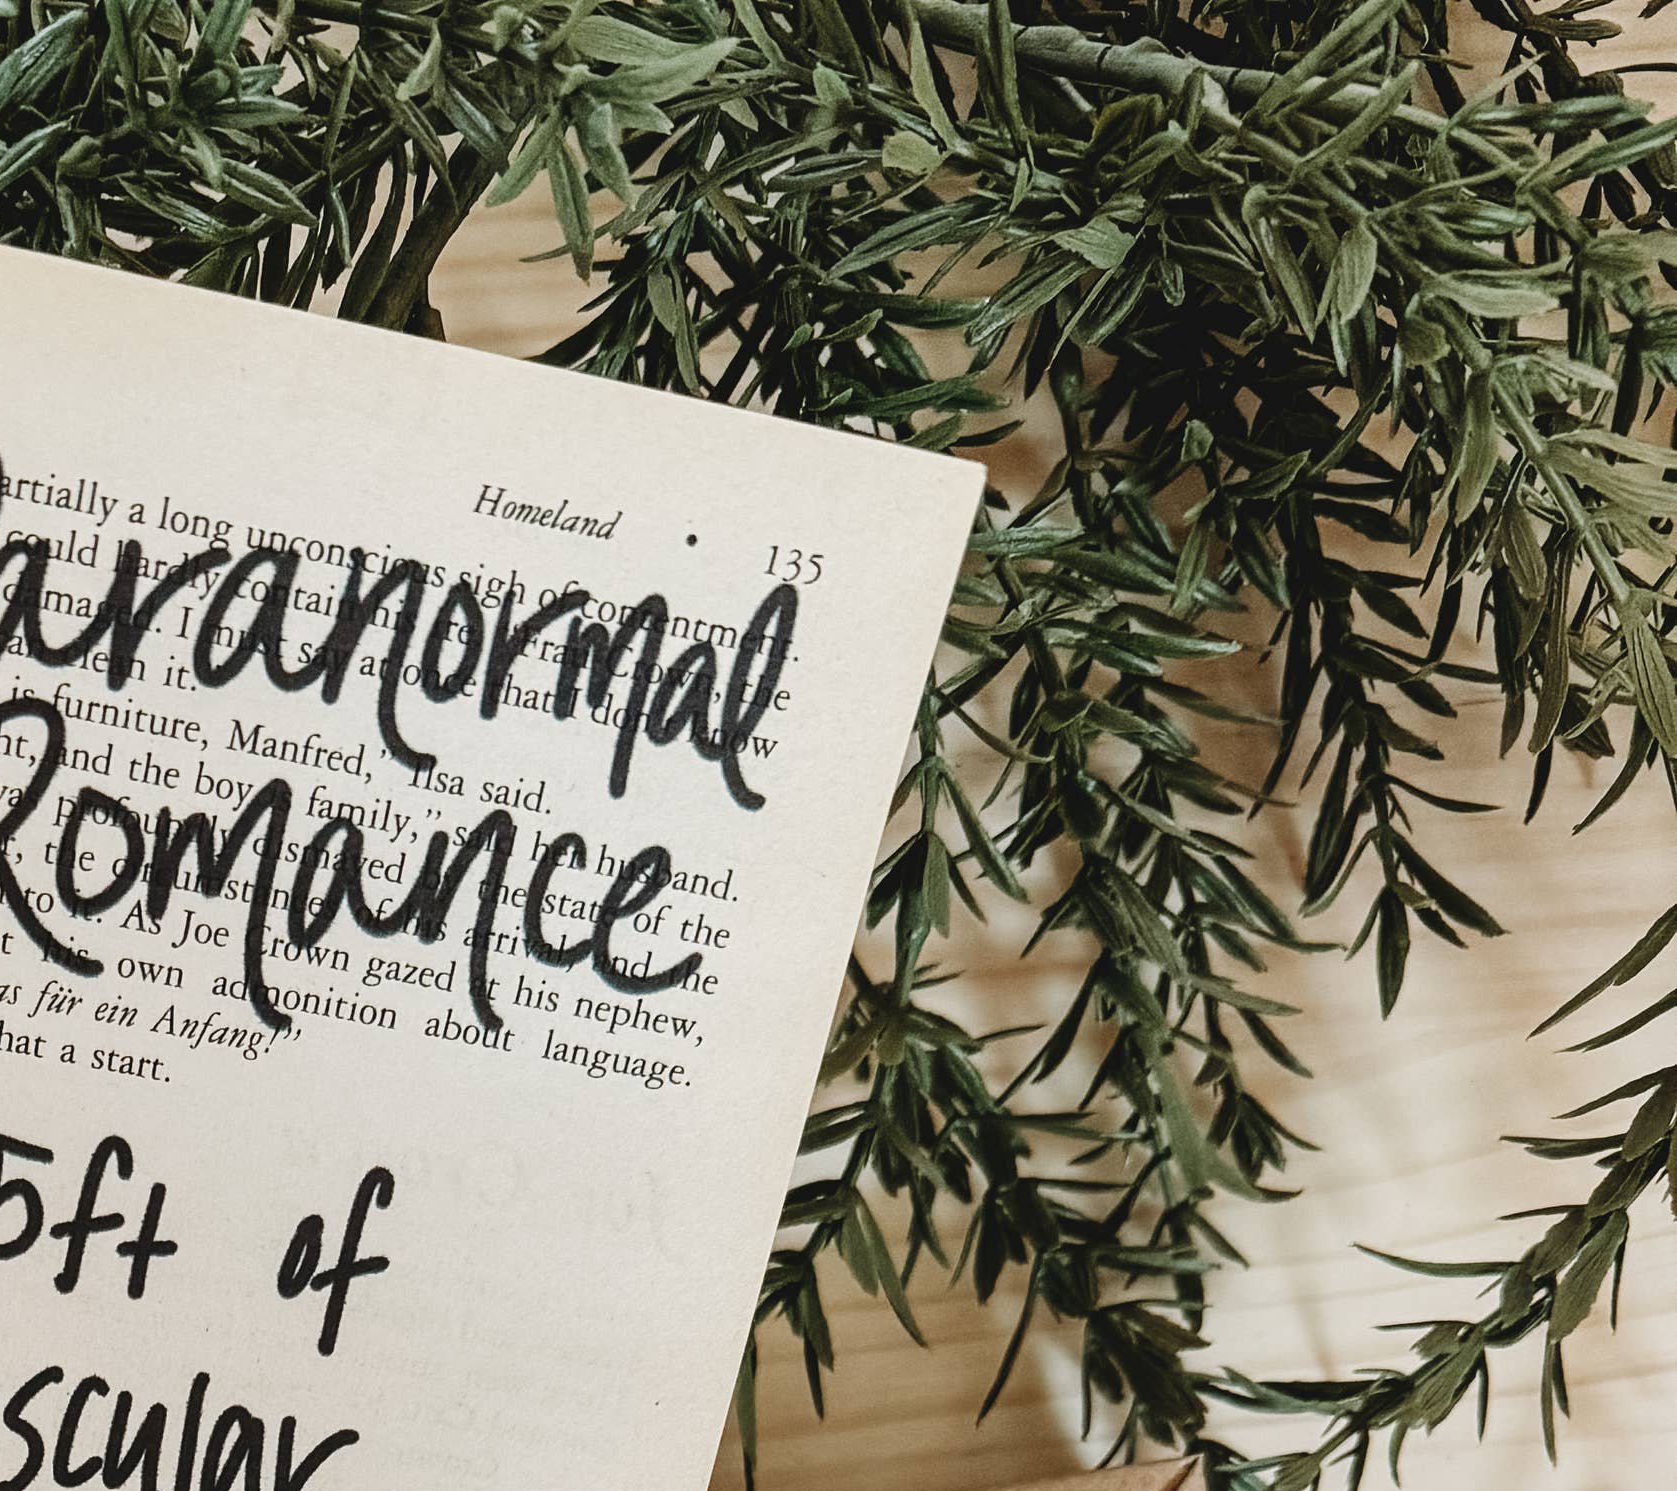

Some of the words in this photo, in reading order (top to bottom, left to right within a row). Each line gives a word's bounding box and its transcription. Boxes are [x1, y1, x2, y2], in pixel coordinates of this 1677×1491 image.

[128, 503, 146, 525] a
[158, 496, 234, 556] long
[247, 526, 446, 588] unconcis
[453, 563, 525, 615] sigh
[538, 580, 580, 617] of
[580, 589, 799, 662] conntmn.
[473, 484, 623, 540] Homeland
[766, 545, 824, 585] 135
[3, 529, 100, 568] could
[232, 565, 361, 624] cotai
[366, 592, 419, 636] hi
[734, 669, 791, 711] te
[65, 634, 146, 681] len
[162, 655, 205, 692] it.
[176, 606, 193, 640] I
[296, 642, 349, 682] sa
[359, 655, 394, 682] at
[491, 670, 559, 714] hat
[590, 689, 684, 741] don
[688, 708, 779, 759] now
[7, 675, 36, 712] is
[47, 682, 208, 752] furniture,
[226, 719, 400, 784] Manfred,”
[408, 755, 464, 797] Ilsa
[479, 777, 551, 815] said.
[49, 730, 114, 776] and
[129, 751, 180, 789] the
[306, 785, 442, 854] family,”
[452, 818, 518, 859] sid
[44, 835, 95, 872] te
[111, 849, 340, 926] crustne
[354, 890, 394, 934] f
[462, 915, 581, 973] arial,
[593, 939, 653, 986] nd
[666, 957, 719, 995] he
[52, 785, 240, 865] pofounly
[252, 822, 407, 885] dsmaed
[538, 886, 618, 930] stat
[633, 896, 673, 935] of
[680, 913, 730, 949] the
[20, 887, 55, 914] to
[119, 894, 168, 935] As
[171, 909, 230, 949] Joe
[361, 957, 457, 993] gazed
[513, 974, 560, 1012] his
[574, 997, 703, 1047] nephew,
[26, 979, 84, 1018] für
[94, 995, 138, 1027] ein
[149, 1004, 302, 1061] Anfang!”
[117, 957, 184, 988] own
[211, 967, 397, 1030] admonition
[424, 1008, 516, 1052] about
[541, 1029, 691, 1090] language.
[59, 1044, 76, 1064] a
[90, 1049, 170, 1083] start.
[277, 1166, 395, 1357] of
